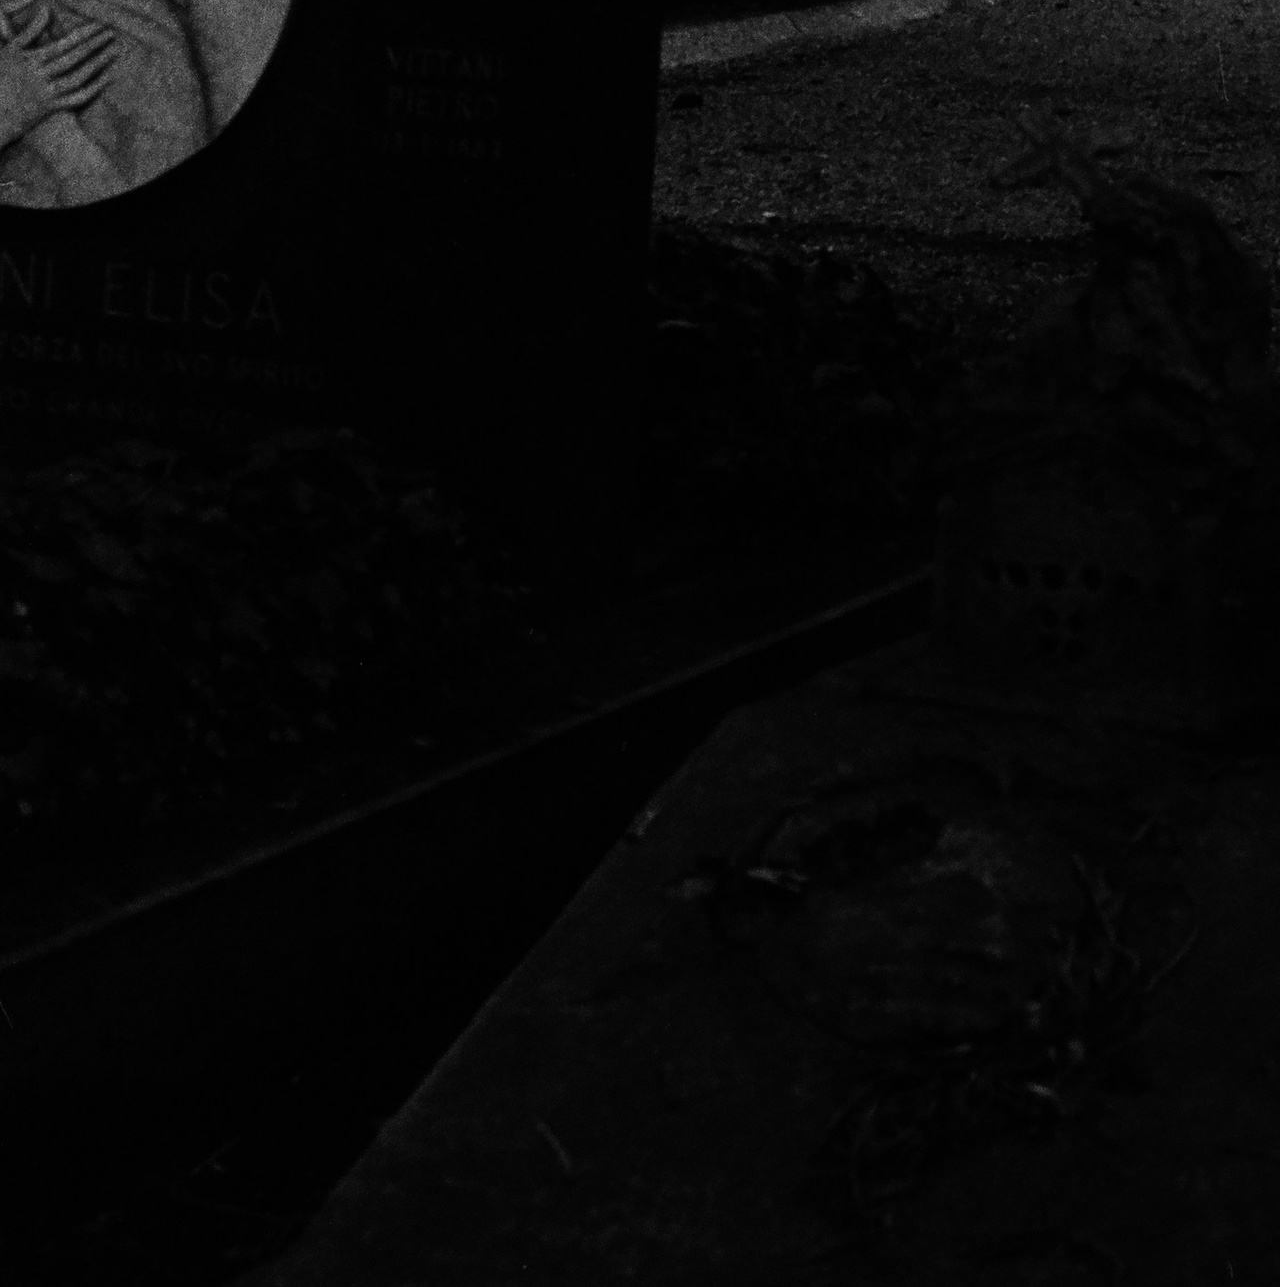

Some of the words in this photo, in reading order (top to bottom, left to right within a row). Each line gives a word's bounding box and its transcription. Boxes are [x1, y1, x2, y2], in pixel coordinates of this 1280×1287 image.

[386, 44, 505, 80] VITTANI
[386, 84, 498, 121] PIETRO
[103, 260, 282, 334] ELISA
[96, 340, 144, 371] DEL
[160, 347, 215, 378] SVO
[226, 355, 326, 391] SPIRITO
